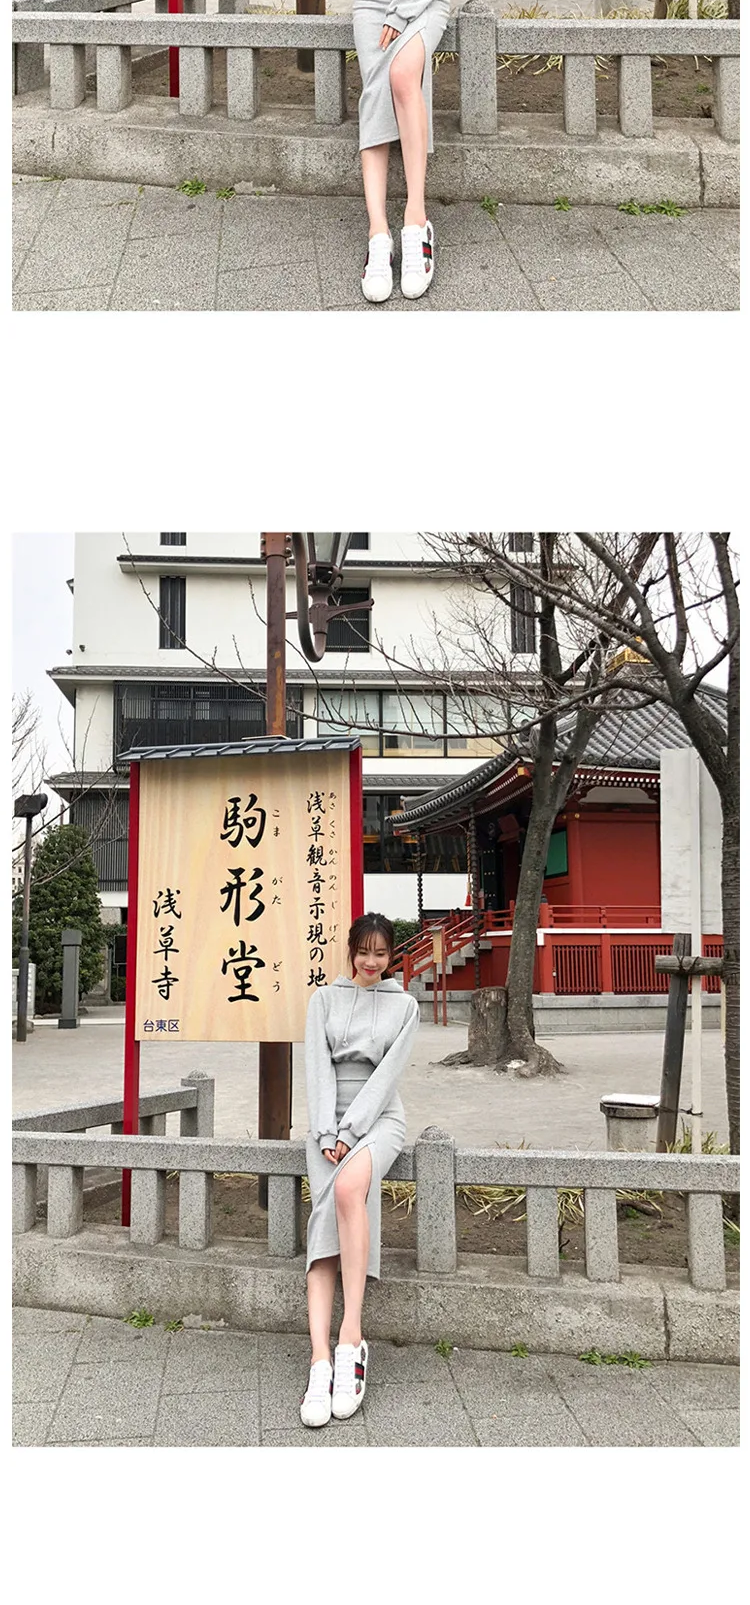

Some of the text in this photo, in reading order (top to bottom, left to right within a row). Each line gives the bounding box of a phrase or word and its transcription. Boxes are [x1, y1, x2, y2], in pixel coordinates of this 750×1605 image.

[151, 887, 182, 1001] 浅草寺
[219, 793, 267, 1003] 駒形堂
[143, 1019, 180, 1033] 台東区
